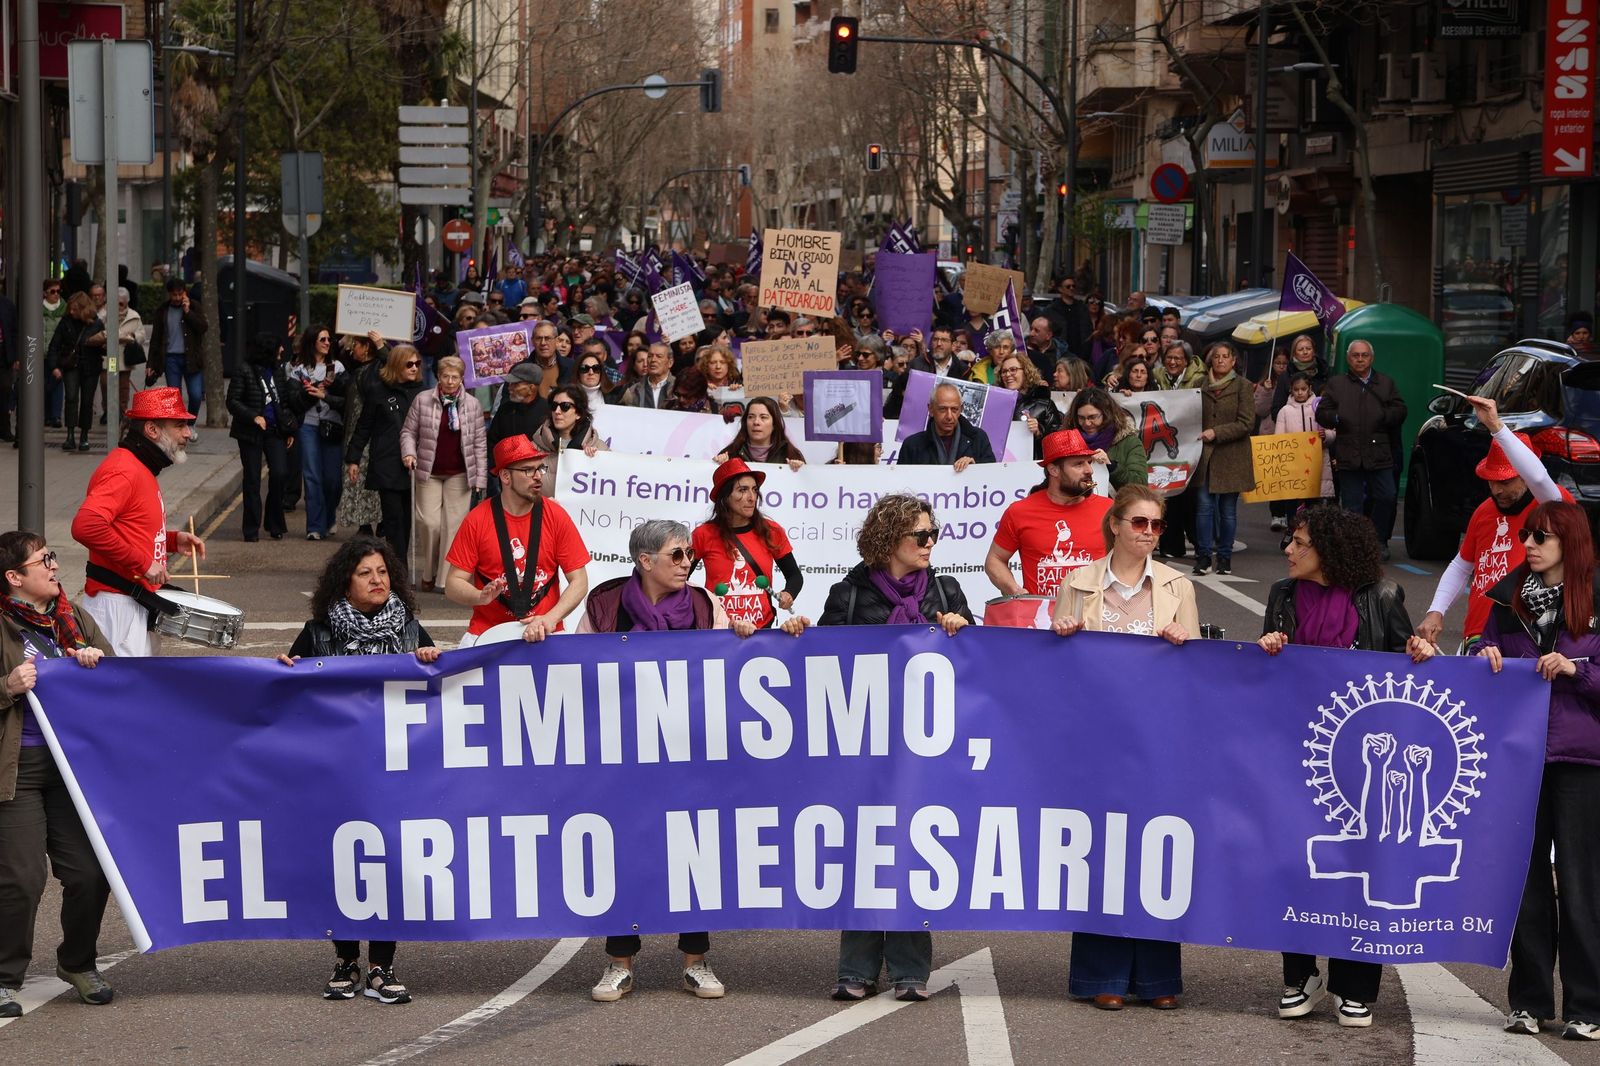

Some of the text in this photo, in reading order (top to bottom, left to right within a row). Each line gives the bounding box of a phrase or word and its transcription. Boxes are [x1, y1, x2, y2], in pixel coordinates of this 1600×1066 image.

[1550, 107, 1590, 121] ropa interior
[1560, 122, 1585, 134] exterior
[776, 233, 832, 251] HOMBRE
[769, 248, 834, 265] BIEN CRIADO
[653, 284, 692, 305] FEMINISTA
[774, 276, 825, 293] APOYA AL
[1295, 275, 1322, 305] UGT
[763, 288, 834, 312] PATRIARCADO
[1256, 439, 1299, 452] JUNTAS
[1257, 452, 1296, 466] SOMOS
[571, 471, 617, 497] Sin
[792, 491, 830, 509] no
[579, 508, 612, 529] No
[384, 650, 992, 771] FEMINISMO,
[178, 804, 1195, 924] EL GRITO NECESARIO
[1282, 906, 1494, 935] Asamblea abierta 8M
[1350, 936, 1425, 956] Zamora
